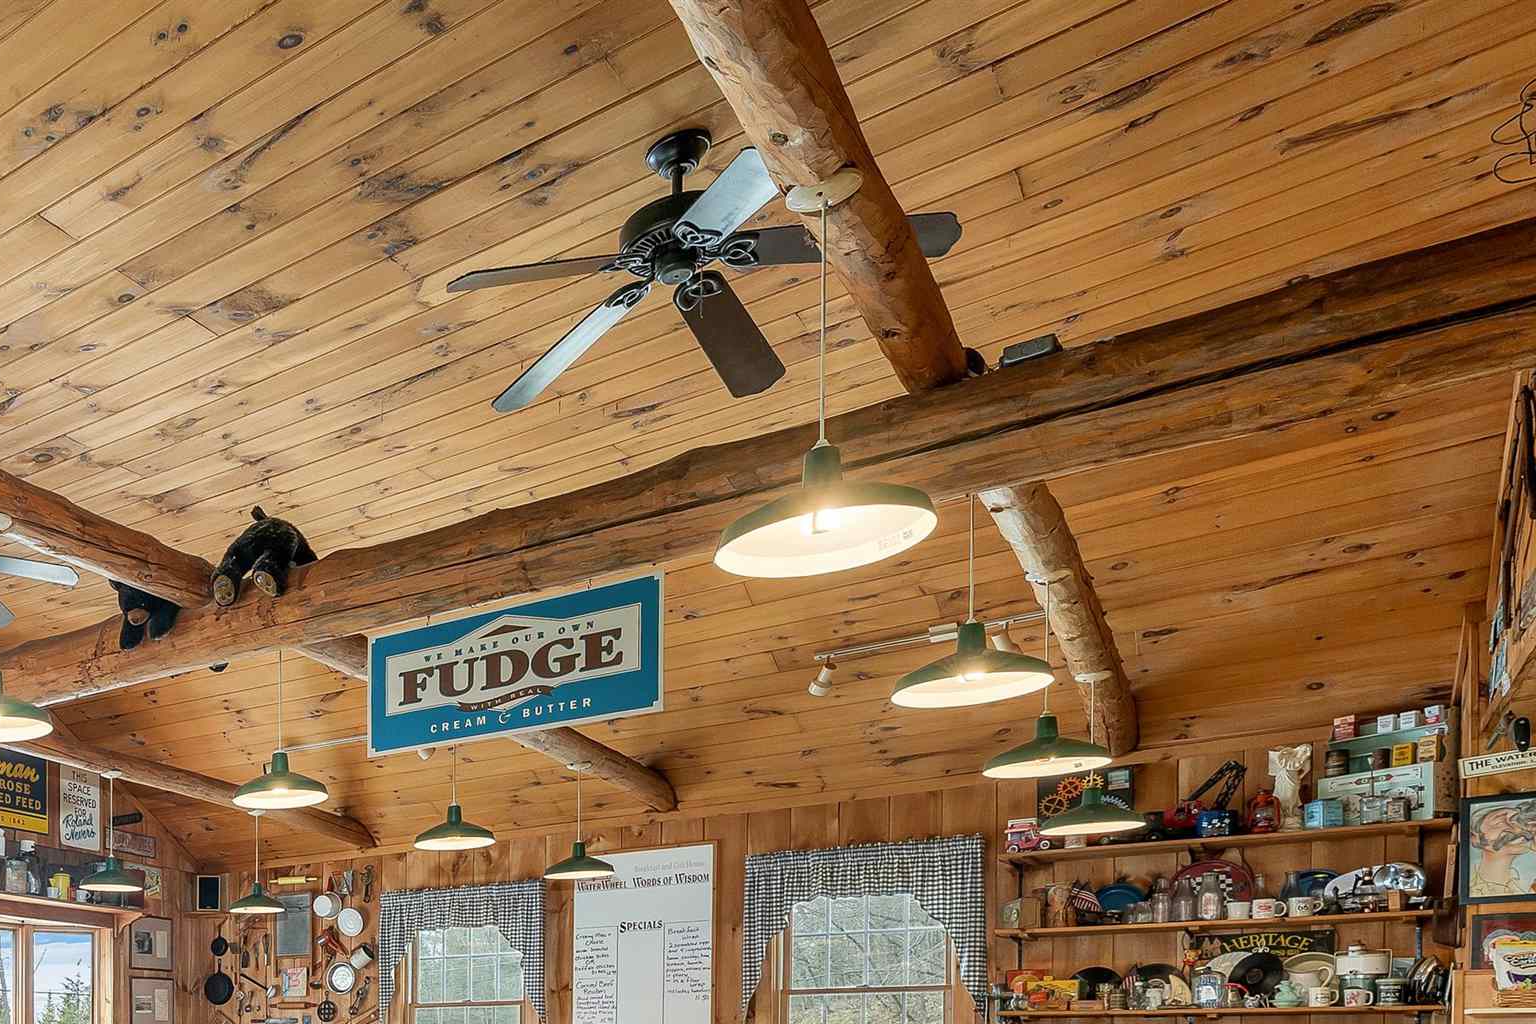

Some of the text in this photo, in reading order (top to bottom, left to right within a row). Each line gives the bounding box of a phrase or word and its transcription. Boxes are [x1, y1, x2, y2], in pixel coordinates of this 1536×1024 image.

[424, 620, 595, 663] WE MAKE OUR OWN
[398, 627, 624, 707] FUDGE
[470, 687, 544, 711] WITH REAL
[430, 715, 487, 733] CREAM
[522, 697, 593, 719] BUTTER
[1468, 760, 1491, 771] THE
[72, 770, 88, 784] THIS
[67, 782, 92, 797] SPACE
[16, 795, 42, 811] FEED
[63, 792, 97, 809] RESERVED
[632, 876, 662, 889] WORDS
[663, 876, 674, 887] OF
[674, 872, 710, 885] WISDOM
[619, 920, 663, 933] SPECIALS
[1222, 933, 1314, 954] HERITAGE
